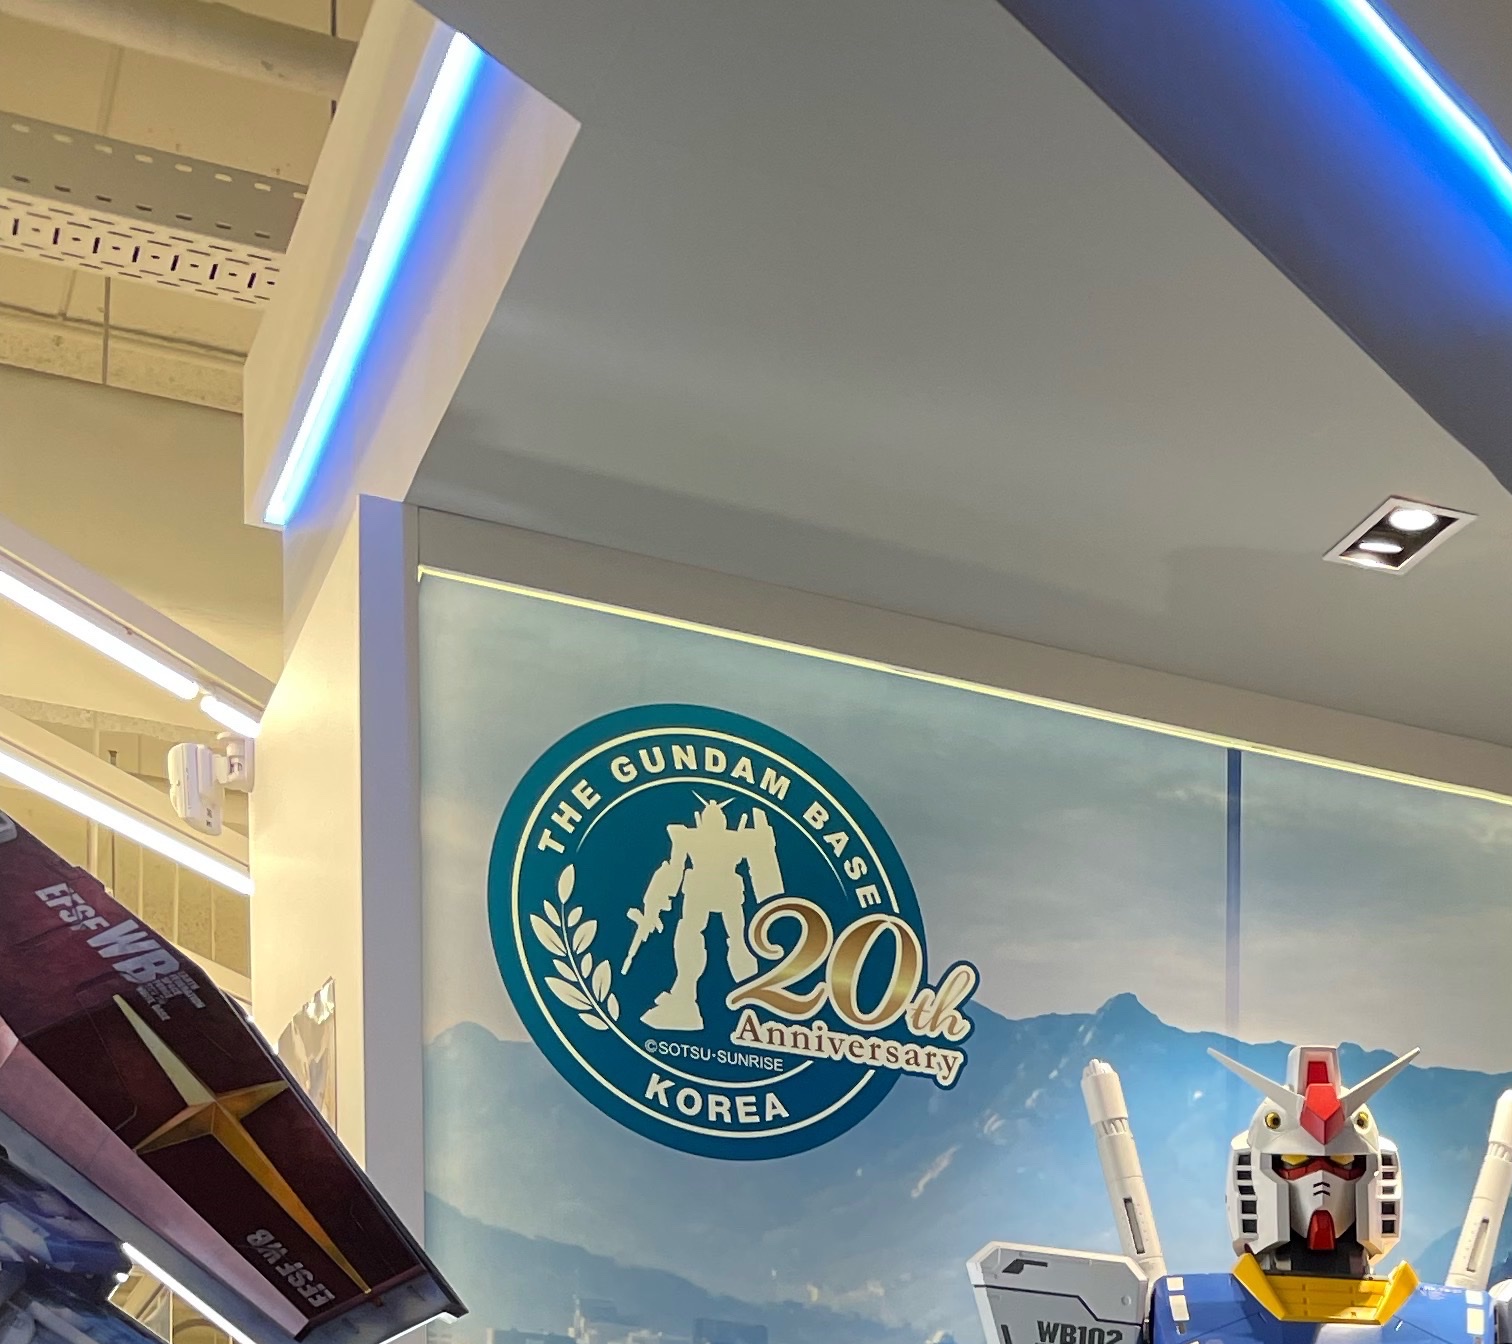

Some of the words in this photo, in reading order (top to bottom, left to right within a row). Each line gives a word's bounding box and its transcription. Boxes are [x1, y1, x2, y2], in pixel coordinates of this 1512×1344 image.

[537, 779, 602, 855] THE
[611, 744, 791, 802] GUNDAM
[802, 800, 883, 909] BASE
[86, 918, 180, 984] WB
[726, 897, 980, 1041] 20th
[731, 1010, 964, 1087] Anniversary
[645, 1072, 790, 1124] KOREA
